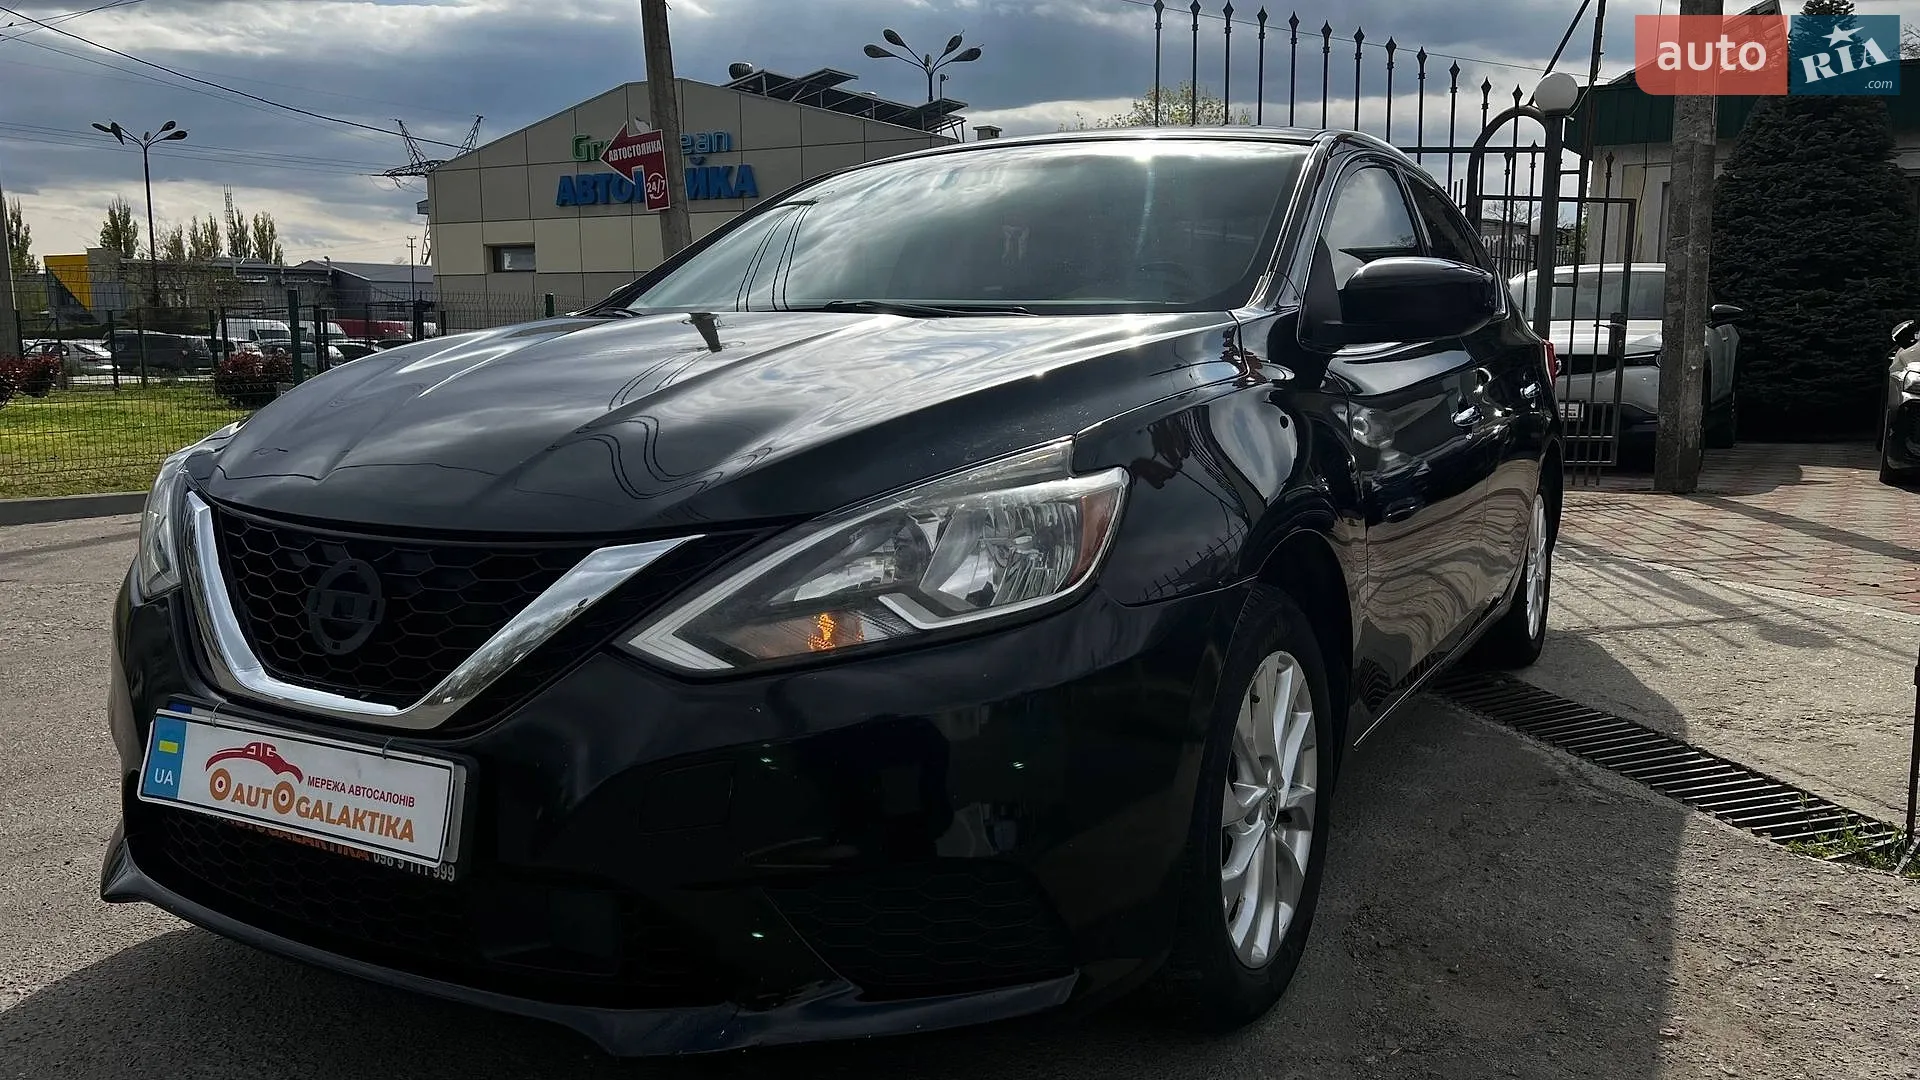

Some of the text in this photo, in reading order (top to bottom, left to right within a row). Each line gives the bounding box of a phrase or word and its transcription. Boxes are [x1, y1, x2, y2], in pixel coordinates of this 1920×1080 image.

[608, 139, 662, 162] АВТОСТОЯНКА
[556, 156, 759, 206] АВТОЙКА
[646, 178, 665, 194] 24/7
[154, 767, 174, 786] UA
[307, 775, 415, 808] МЕРЕЖА АВТОСАЛОНІВ
